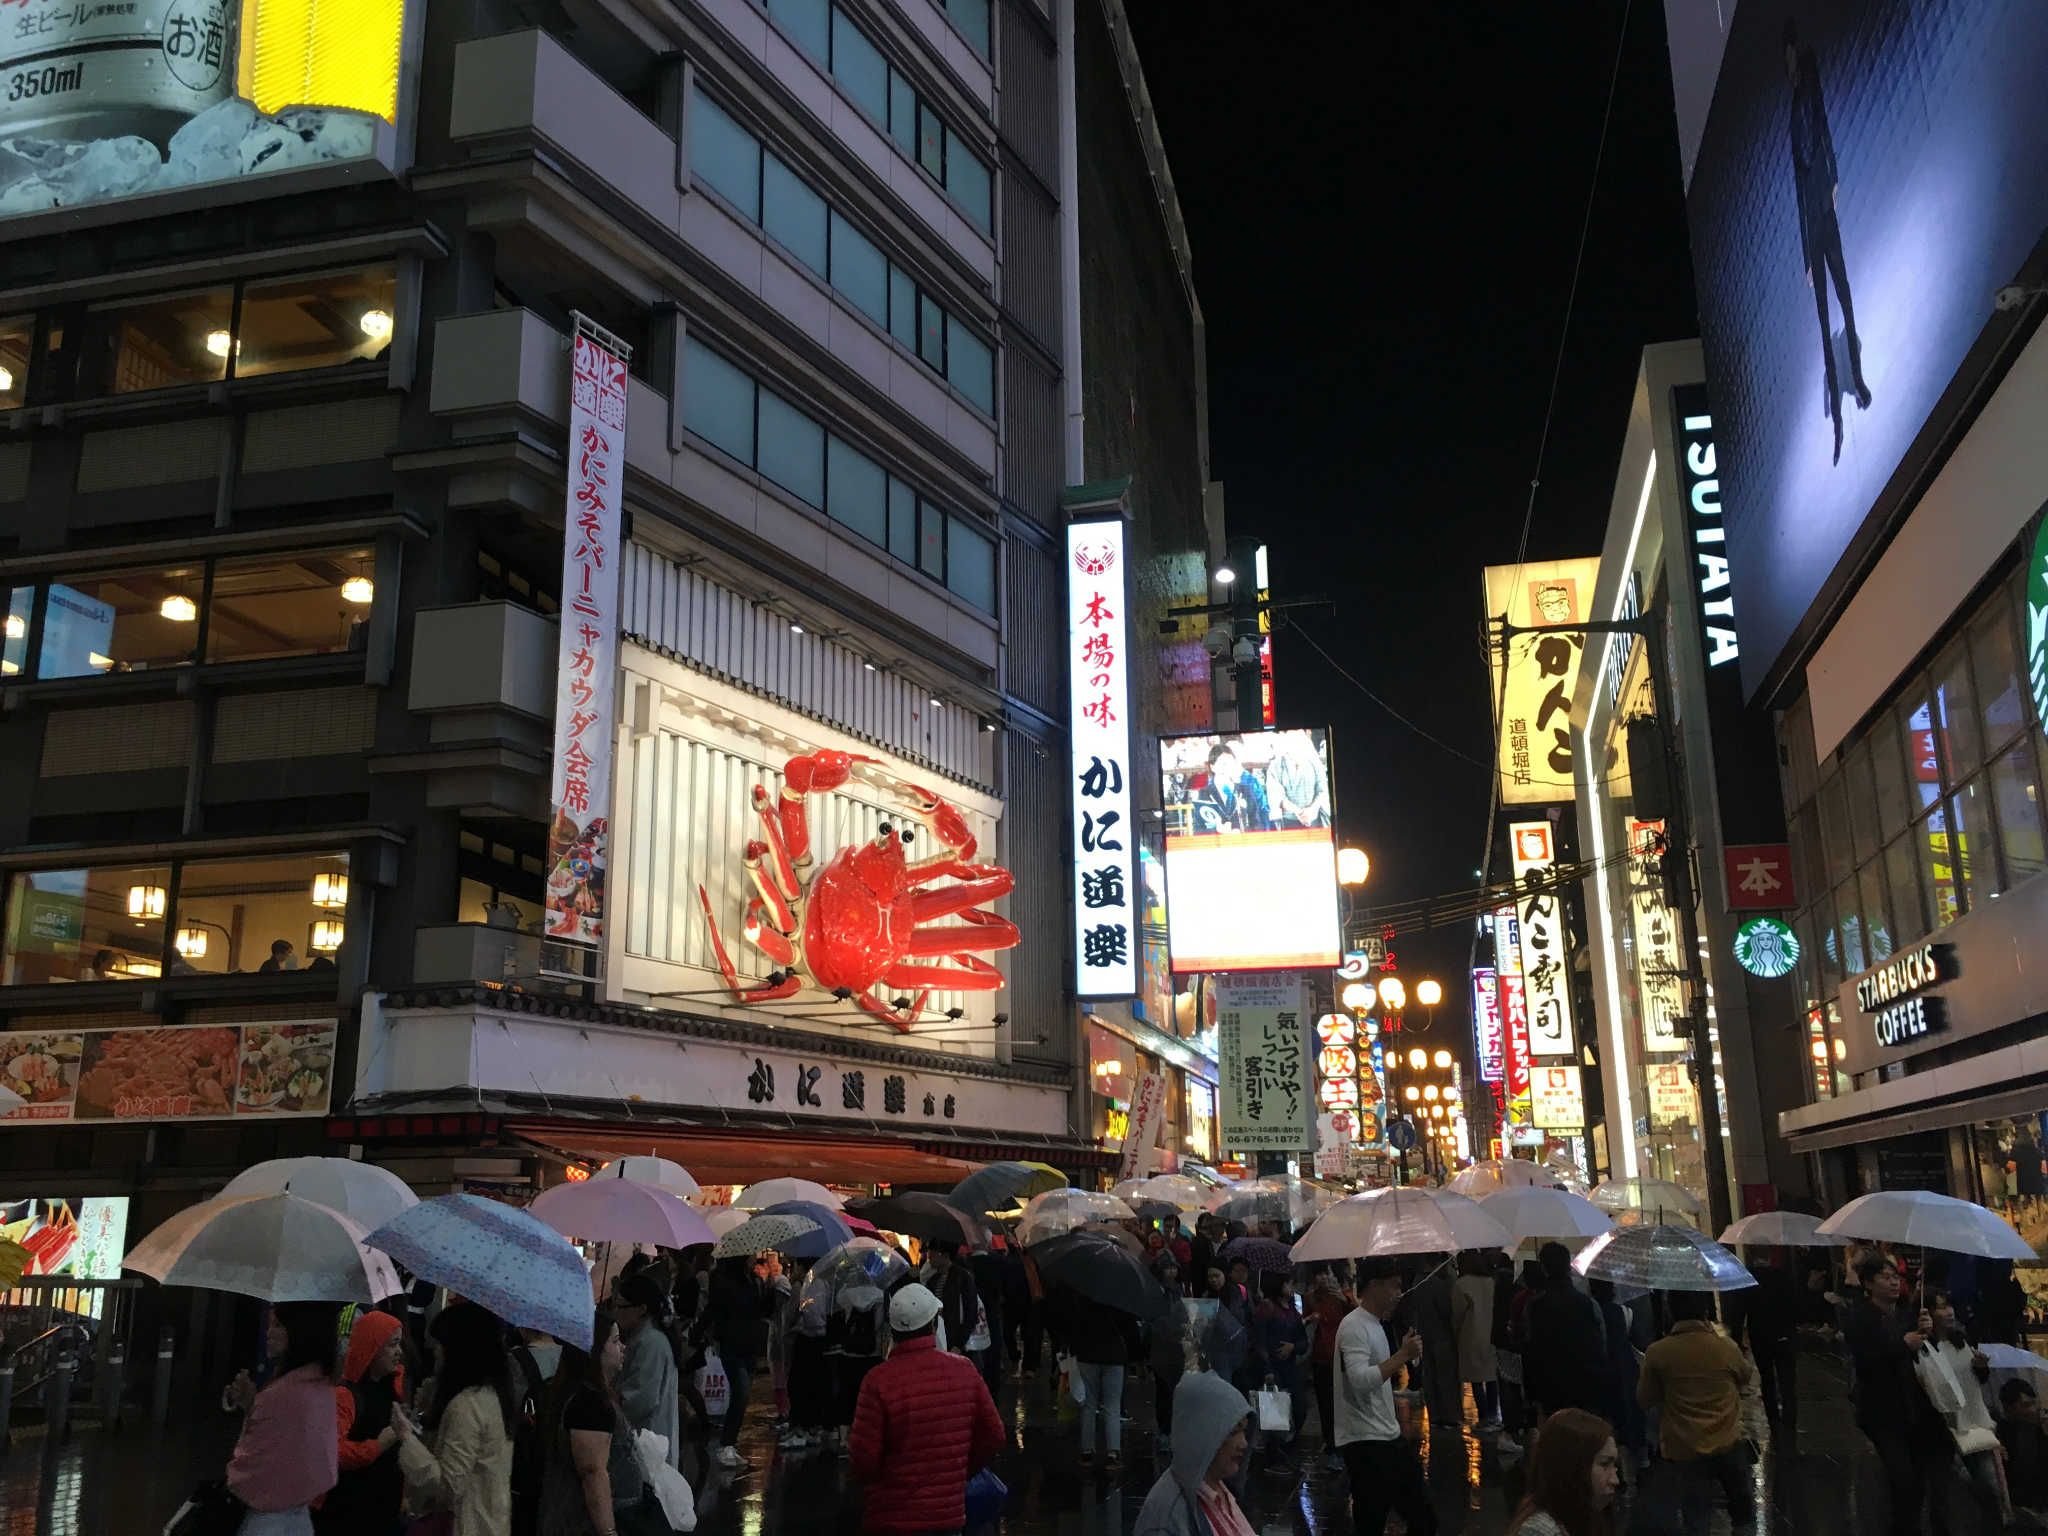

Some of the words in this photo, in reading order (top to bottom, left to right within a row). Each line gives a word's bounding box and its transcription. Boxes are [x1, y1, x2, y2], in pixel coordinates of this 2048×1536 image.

[166, 13, 225, 70] お酒
[9, 62, 83, 101] 350ml
[562, 423, 609, 815] かにみそバーニャカウダ会席
[1080, 591, 1117, 729] 本場の味
[1509, 718, 1531, 786] 道頓堀店
[1736, 857, 1783, 897] 本
[1857, 944, 1936, 1014] STARBUCKS
[1874, 997, 1927, 1047] COFFEE
[1245, 1056, 1264, 1121] 客引き
